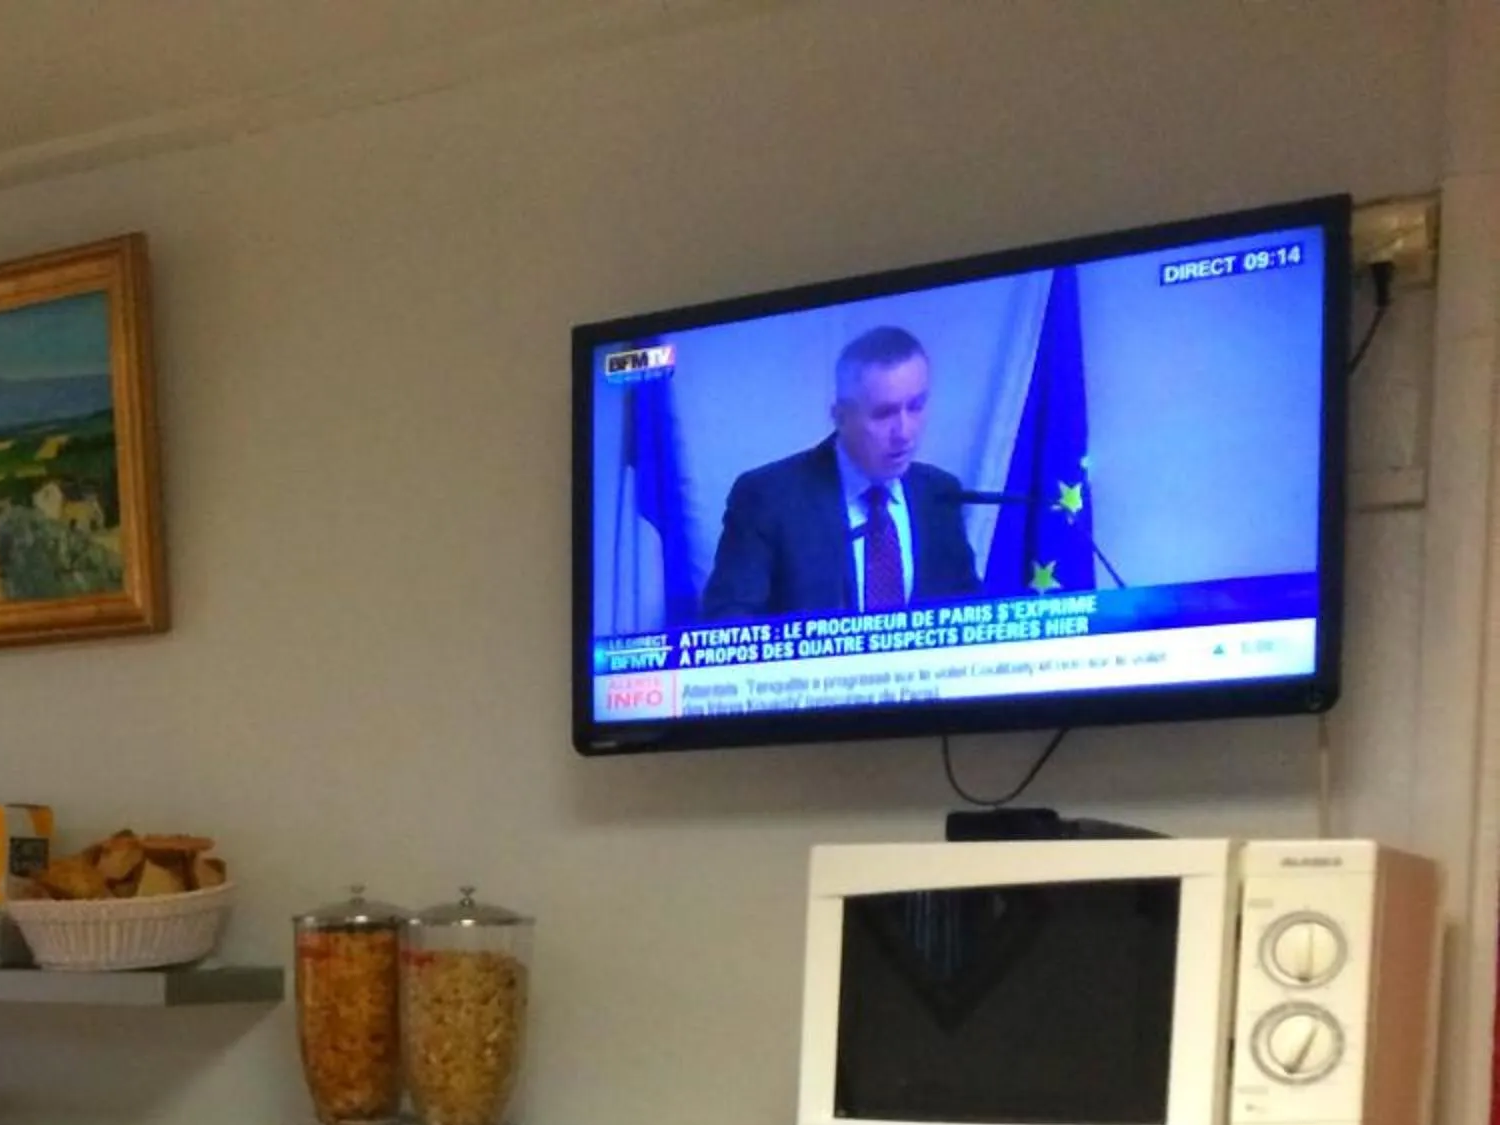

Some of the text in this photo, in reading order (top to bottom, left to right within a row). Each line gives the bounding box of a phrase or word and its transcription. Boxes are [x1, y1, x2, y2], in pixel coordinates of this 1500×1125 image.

[1163, 245, 1301, 283] DIRECT 09:14
[680, 624, 771, 649] ATTENTATS
[784, 621, 802, 639] LE
[806, 612, 907, 637] PROCUREUR
[911, 610, 934, 628] DE
[939, 604, 992, 625] PARIS
[998, 595, 1097, 621] S'EXPRIME
[695, 644, 759, 664] PROPOS
[763, 641, 794, 659] DES
[798, 635, 864, 657] QUATRE
[868, 627, 959, 651] SUSPECTS
[1045, 616, 1089, 637] HIER
[607, 690, 663, 711] INFO
